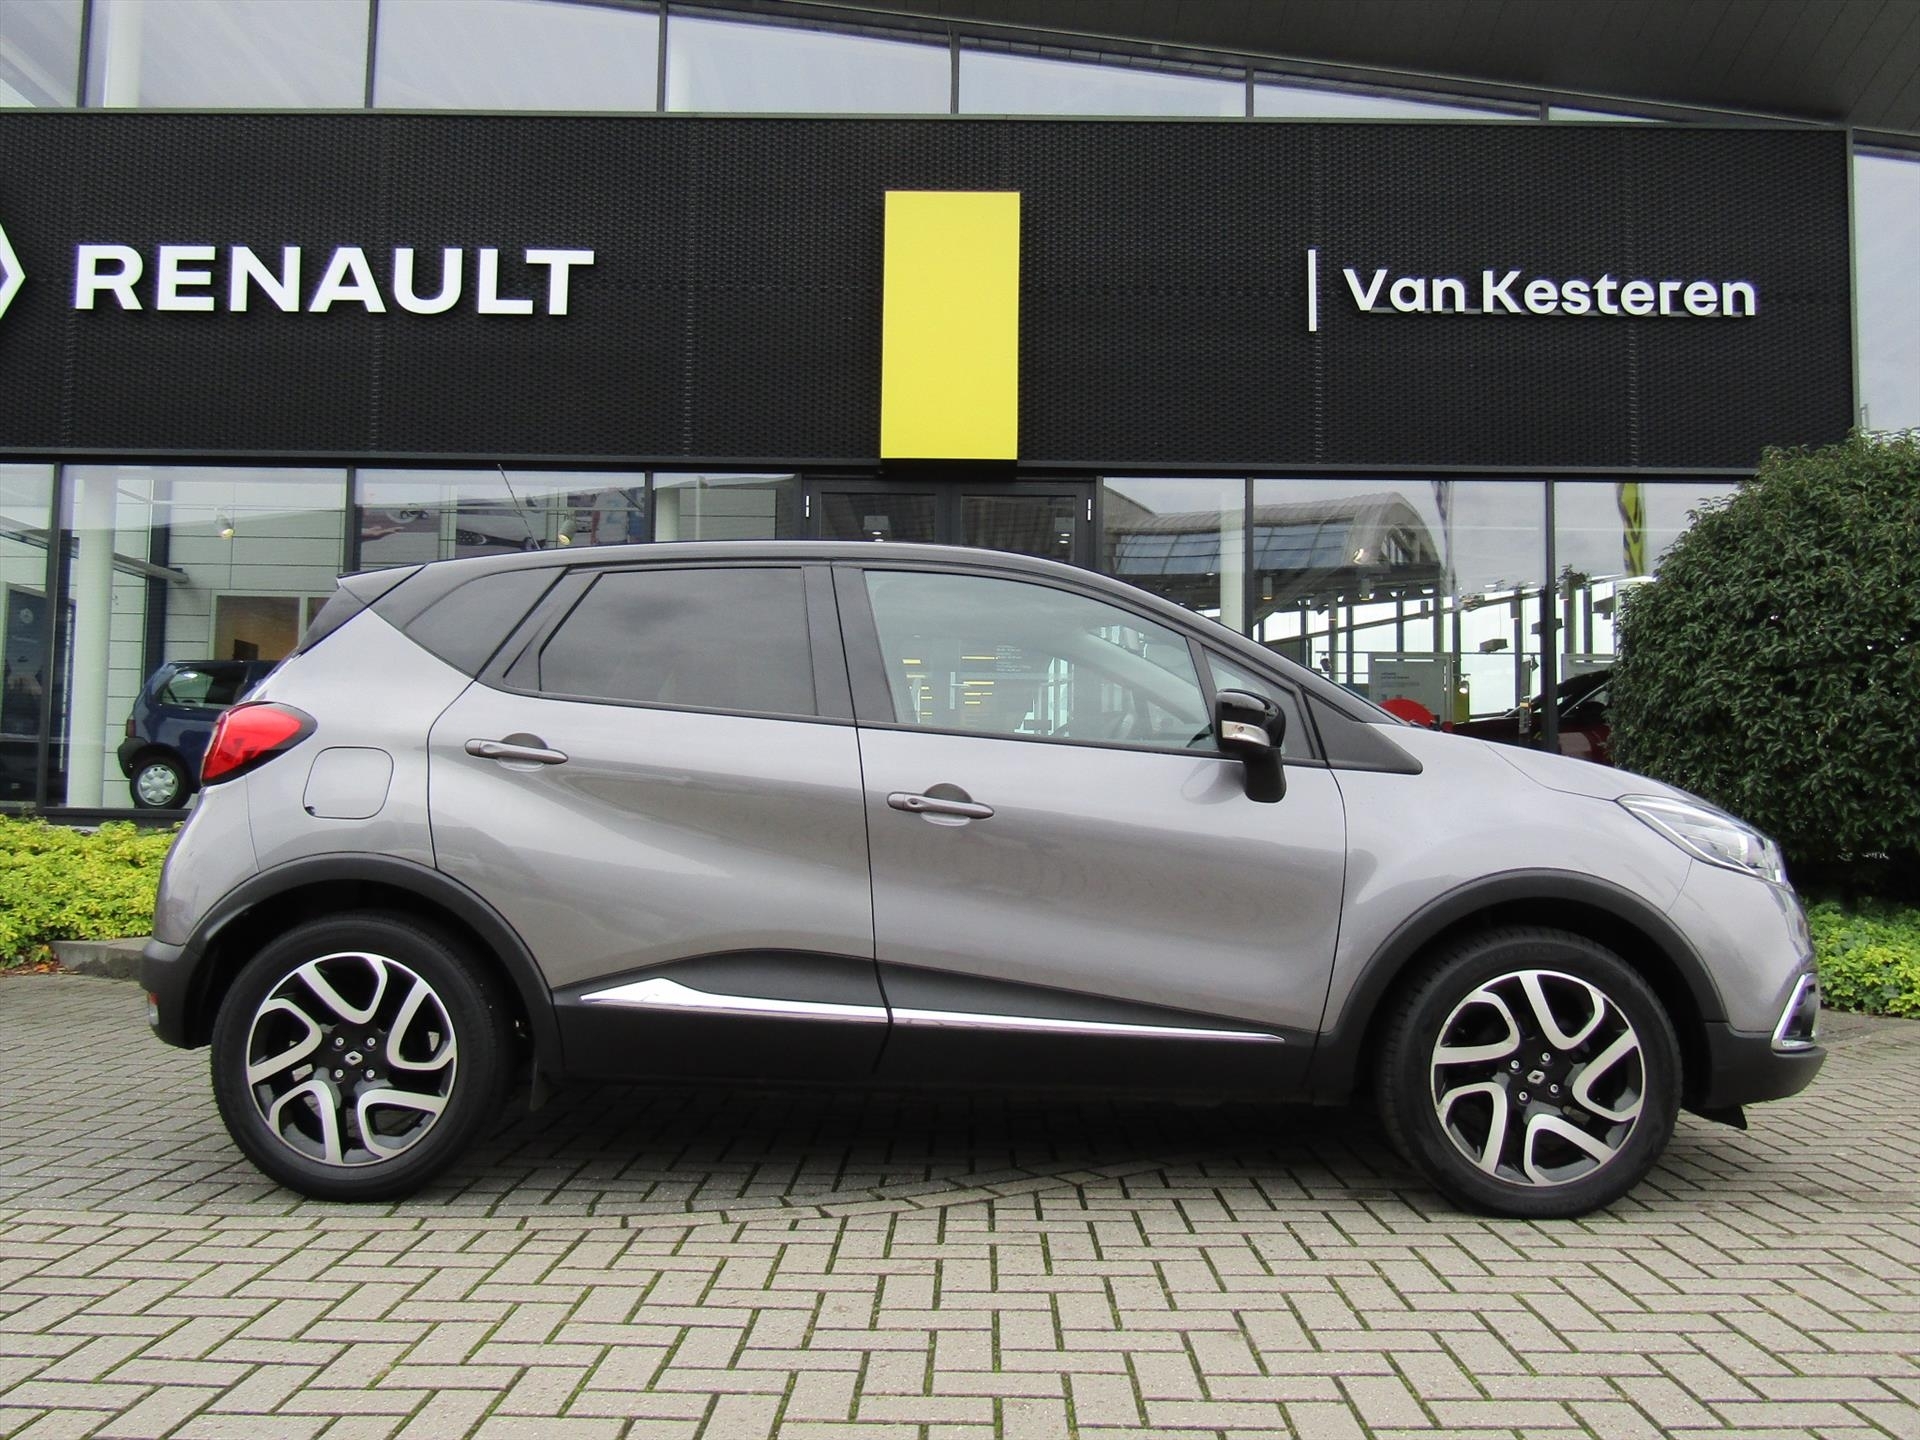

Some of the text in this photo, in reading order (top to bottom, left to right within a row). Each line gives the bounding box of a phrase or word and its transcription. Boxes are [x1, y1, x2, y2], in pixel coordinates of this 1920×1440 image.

[74, 244, 595, 316] RENAULT
[1342, 268, 1756, 316] Van Kesteren
